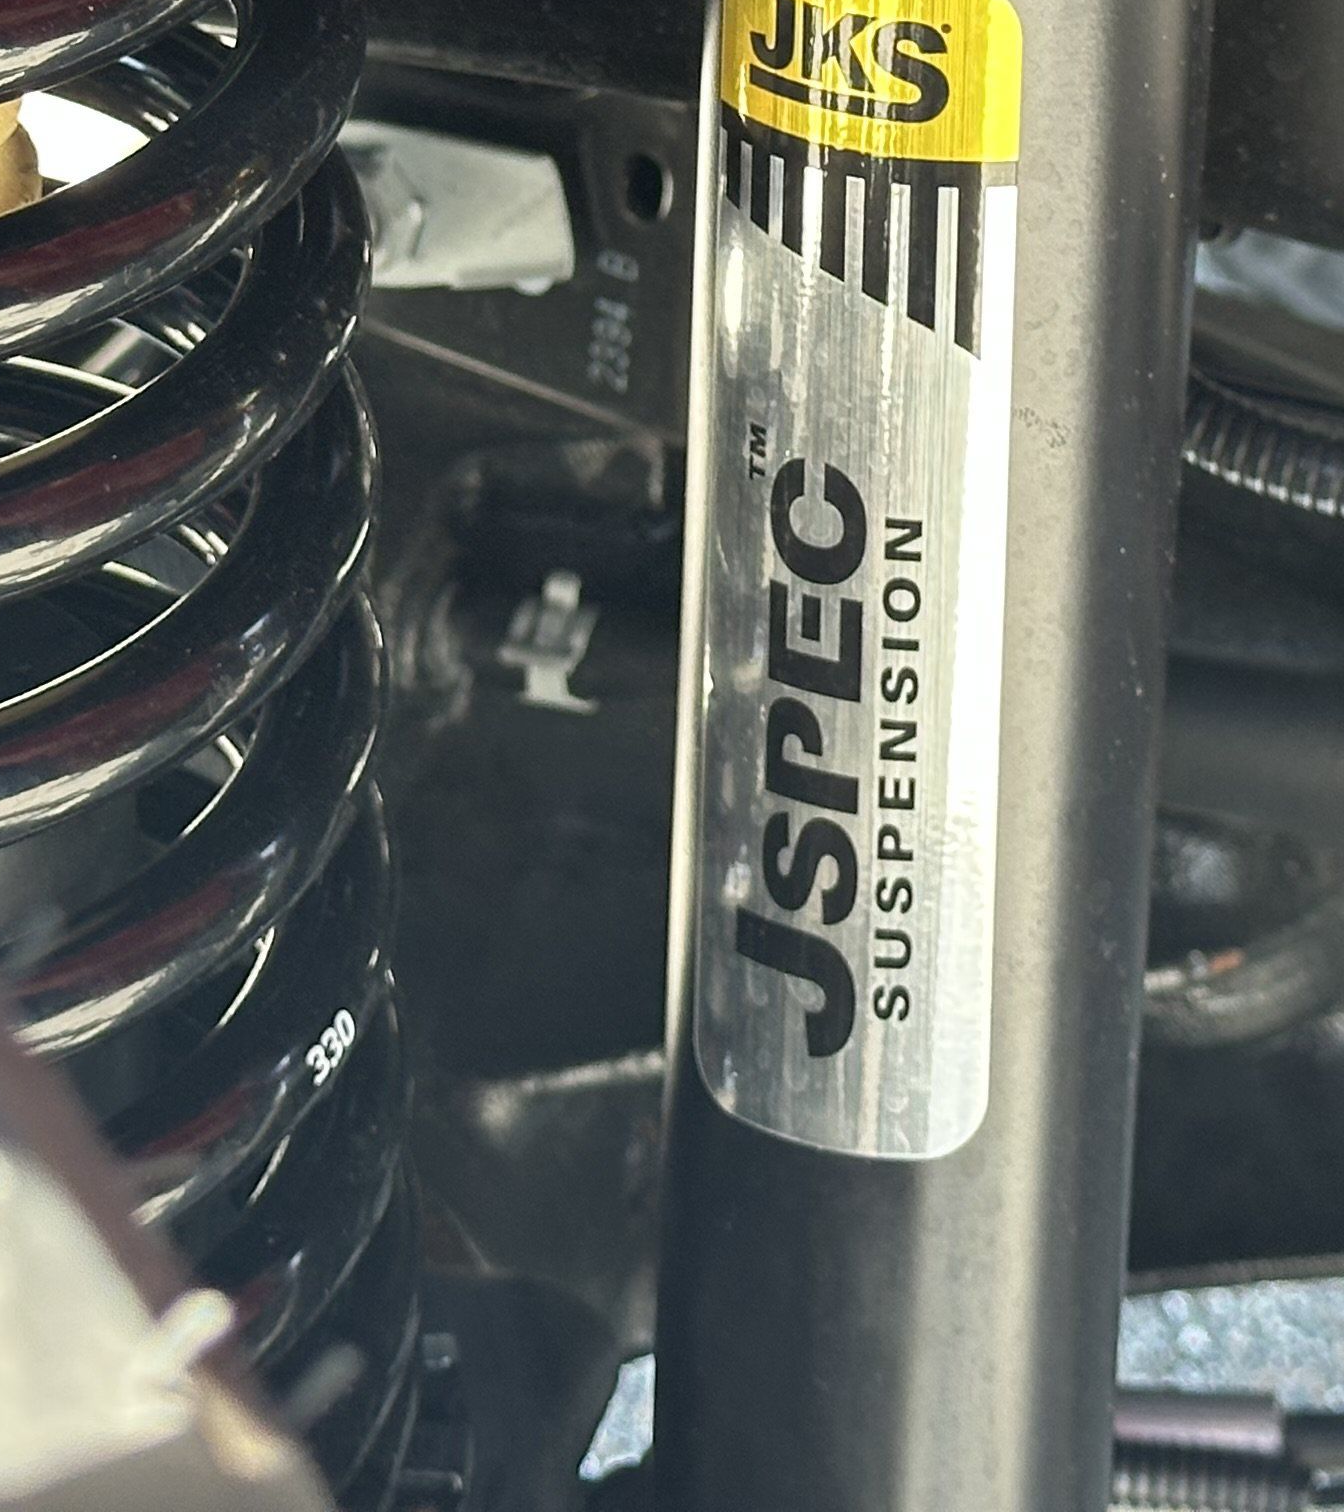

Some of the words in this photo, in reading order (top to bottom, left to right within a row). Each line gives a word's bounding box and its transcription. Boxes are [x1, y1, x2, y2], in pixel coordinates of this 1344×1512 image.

[735, 457, 867, 1058] JSPEC
[872, 516, 924, 1023] SUSPENSION
[305, 1008, 356, 1087] 330
